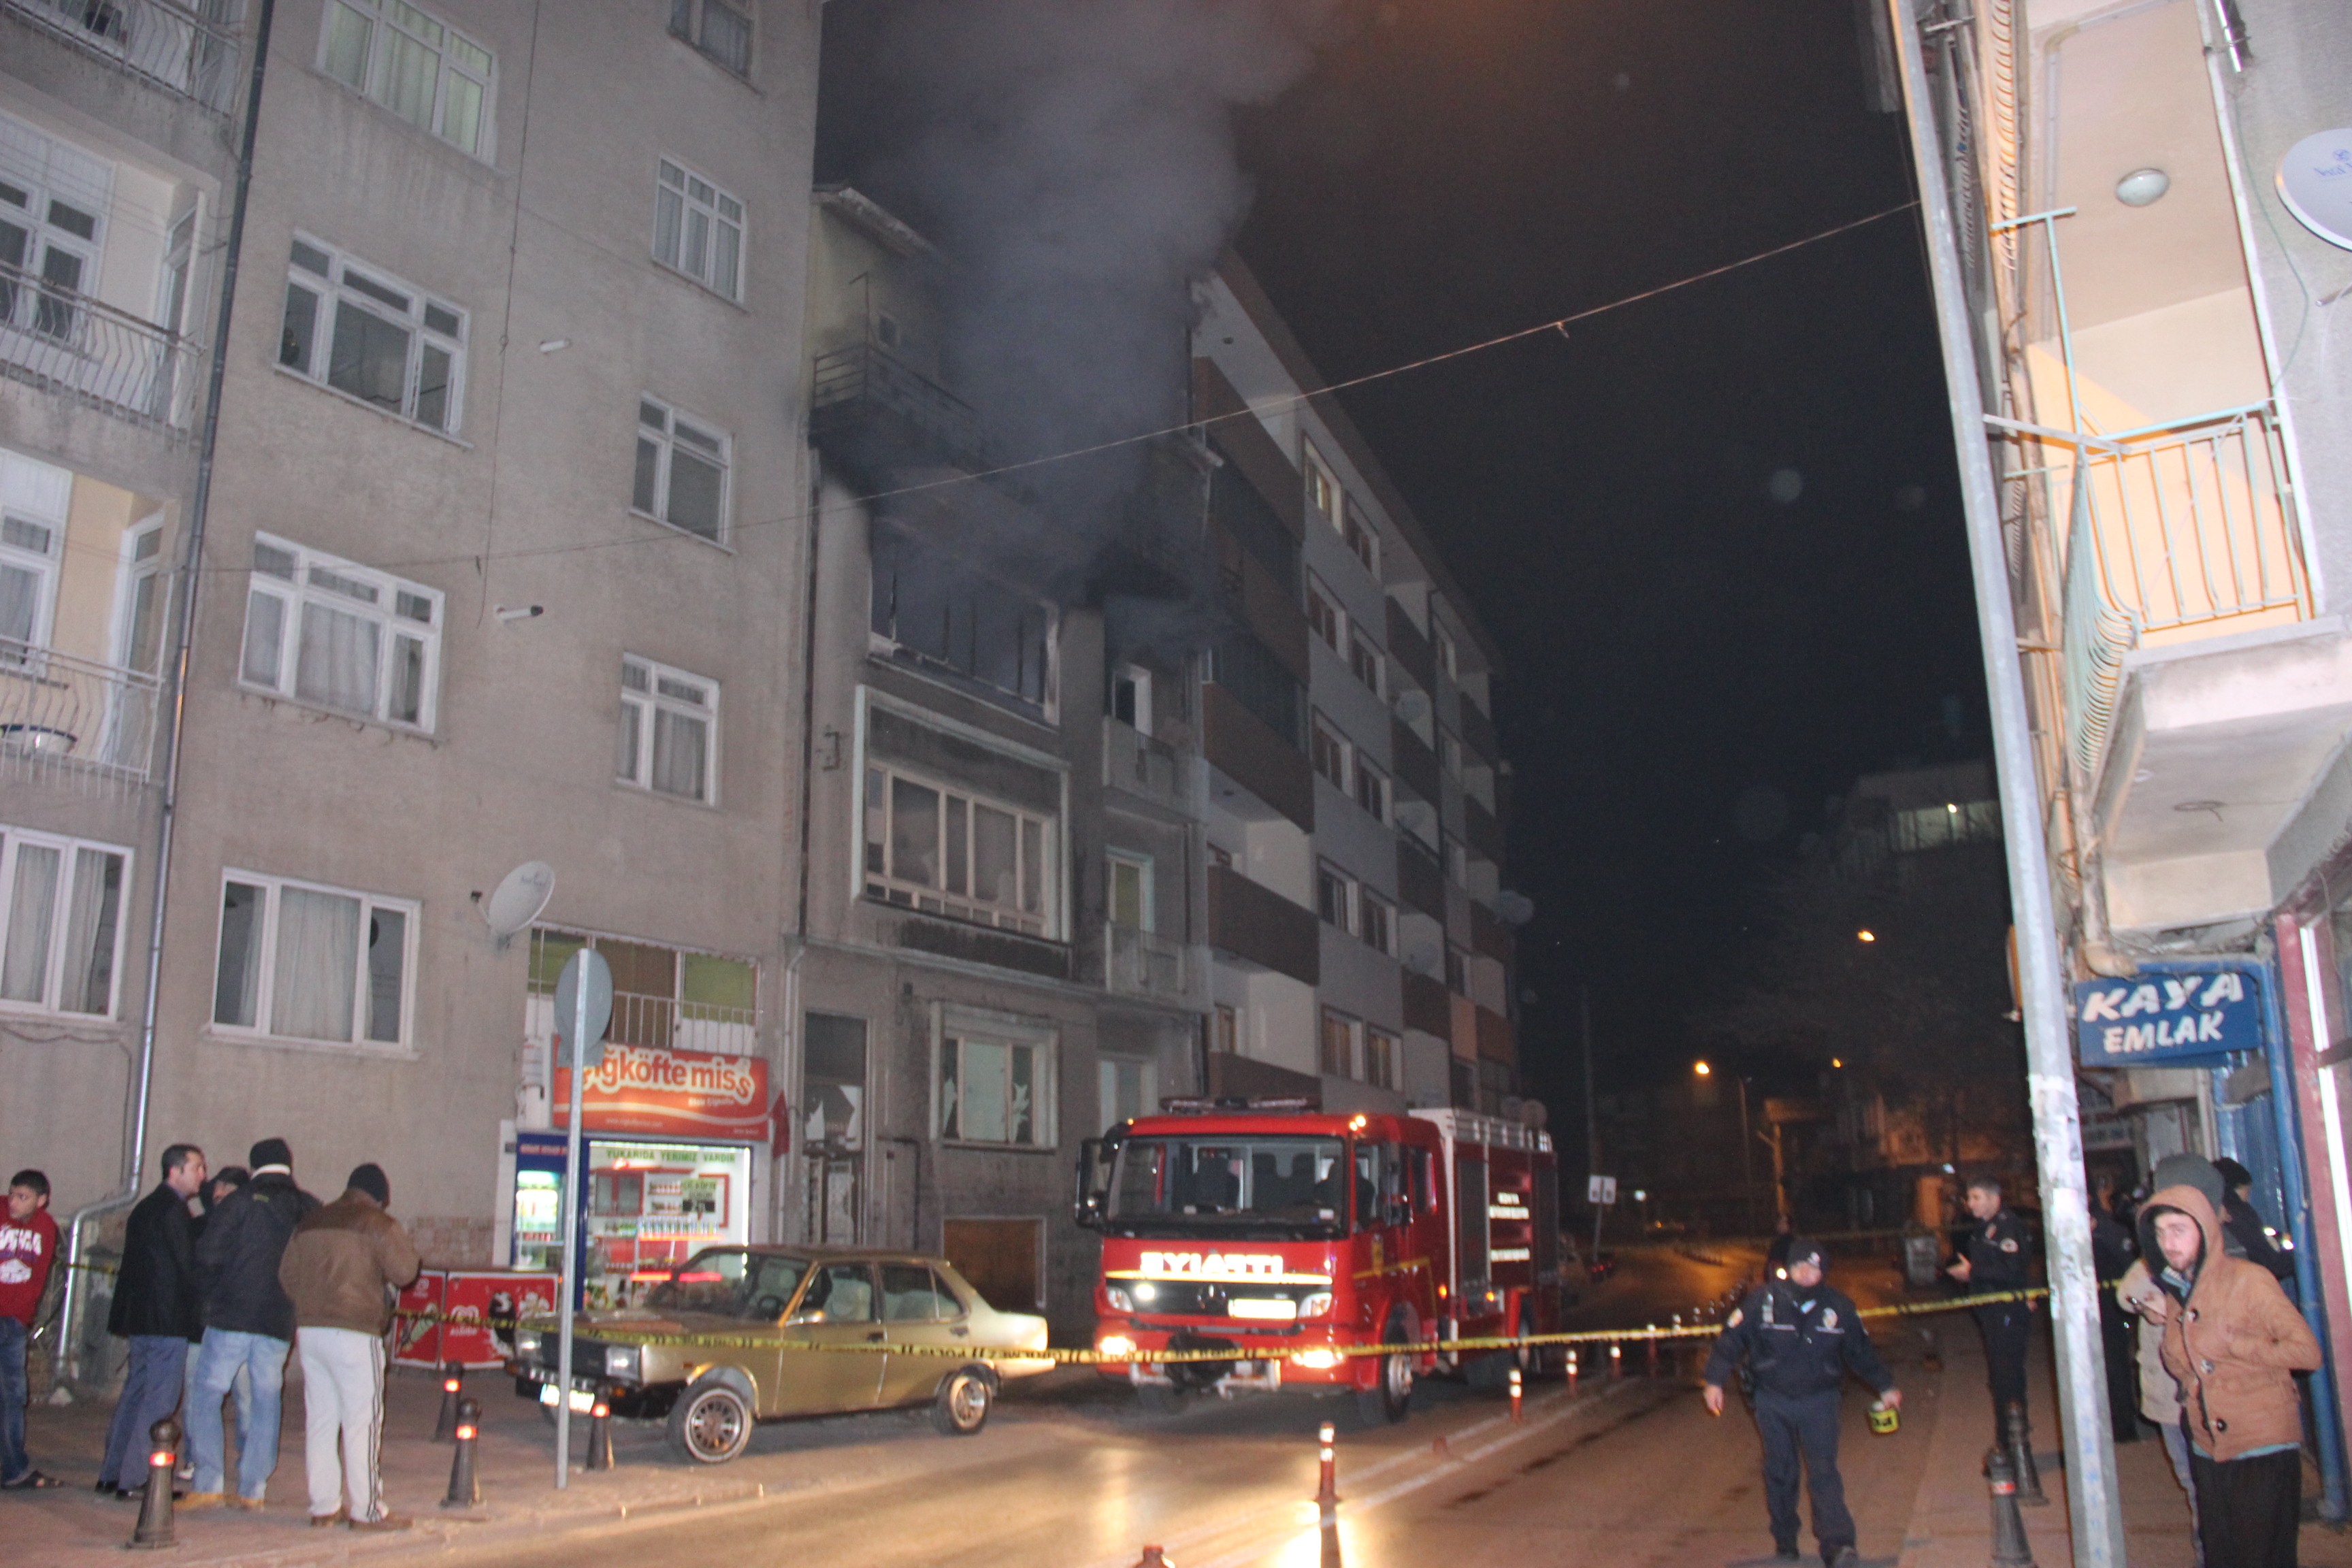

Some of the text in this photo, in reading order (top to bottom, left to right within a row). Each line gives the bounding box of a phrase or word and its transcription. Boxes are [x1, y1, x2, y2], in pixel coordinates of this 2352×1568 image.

[2081, 972, 2244, 1023] KAYA
[2104, 1011, 2224, 1054] EMLAK
[691, 1060, 751, 1098] miss
